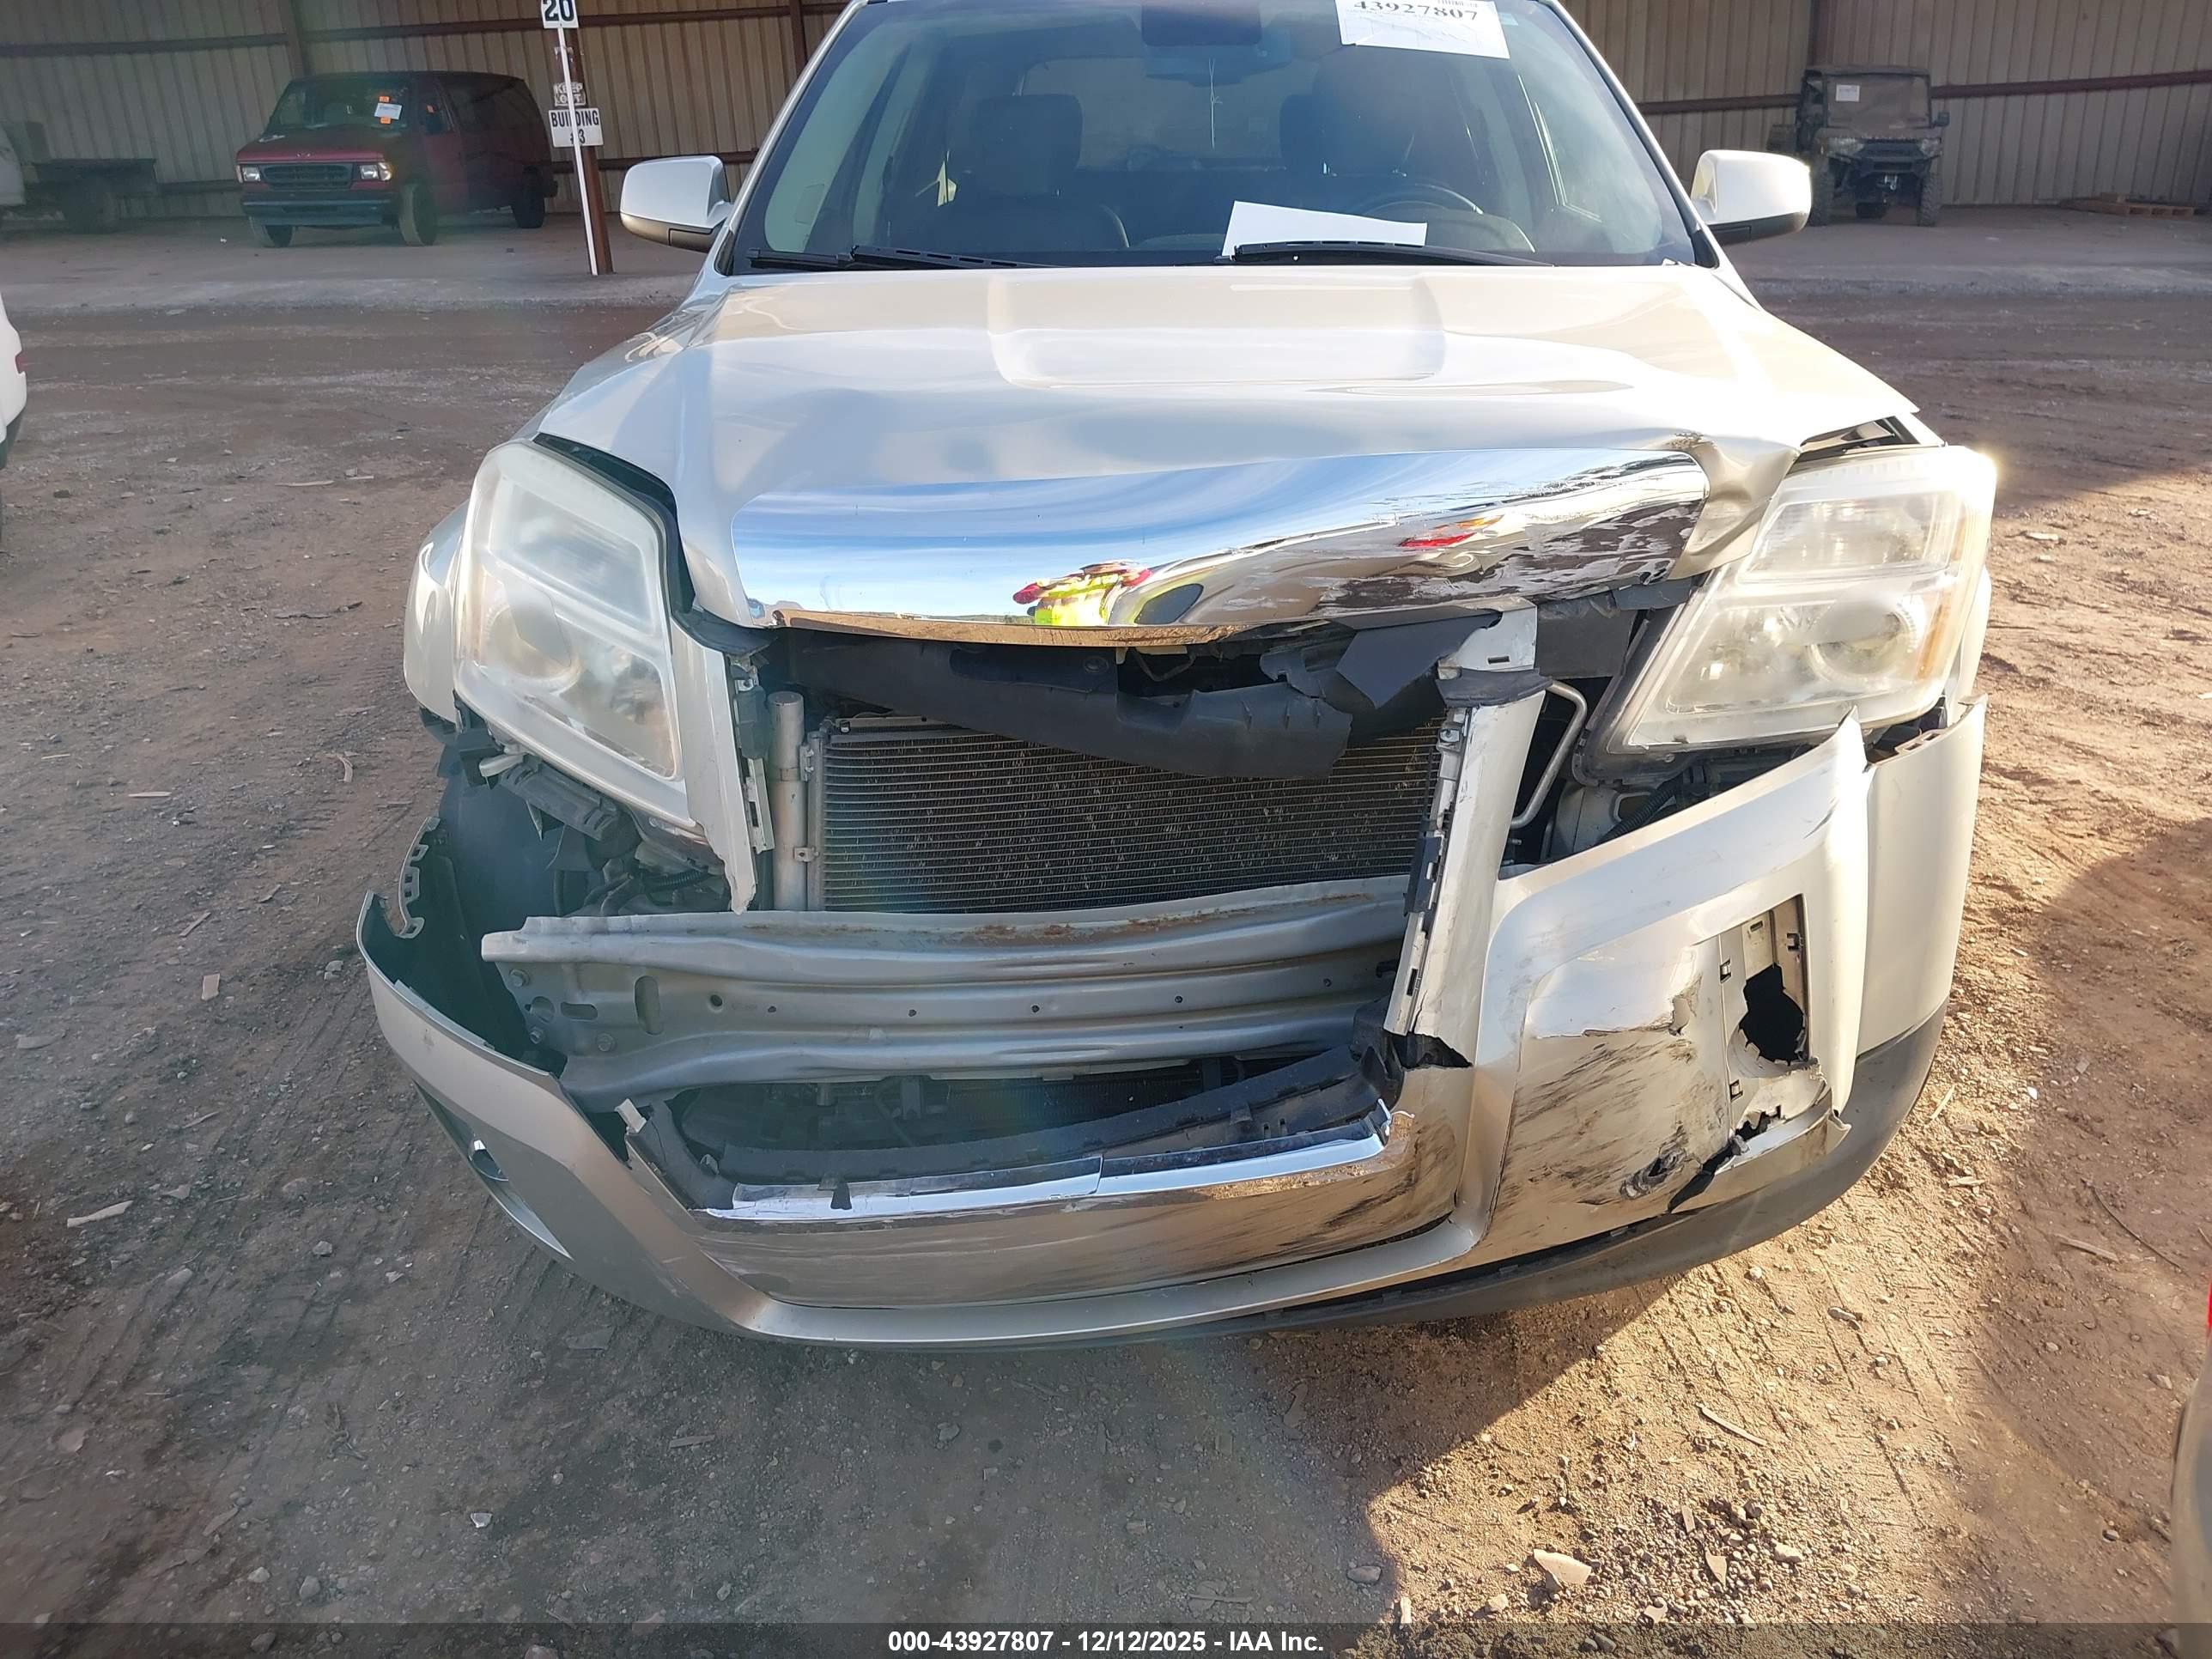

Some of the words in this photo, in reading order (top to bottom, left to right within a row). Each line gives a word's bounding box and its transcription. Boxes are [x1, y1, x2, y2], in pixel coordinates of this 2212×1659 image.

[543, 0, 574, 21] 20
[1353, 0, 1478, 21] 43927807
[559, 94, 581, 103] OT
